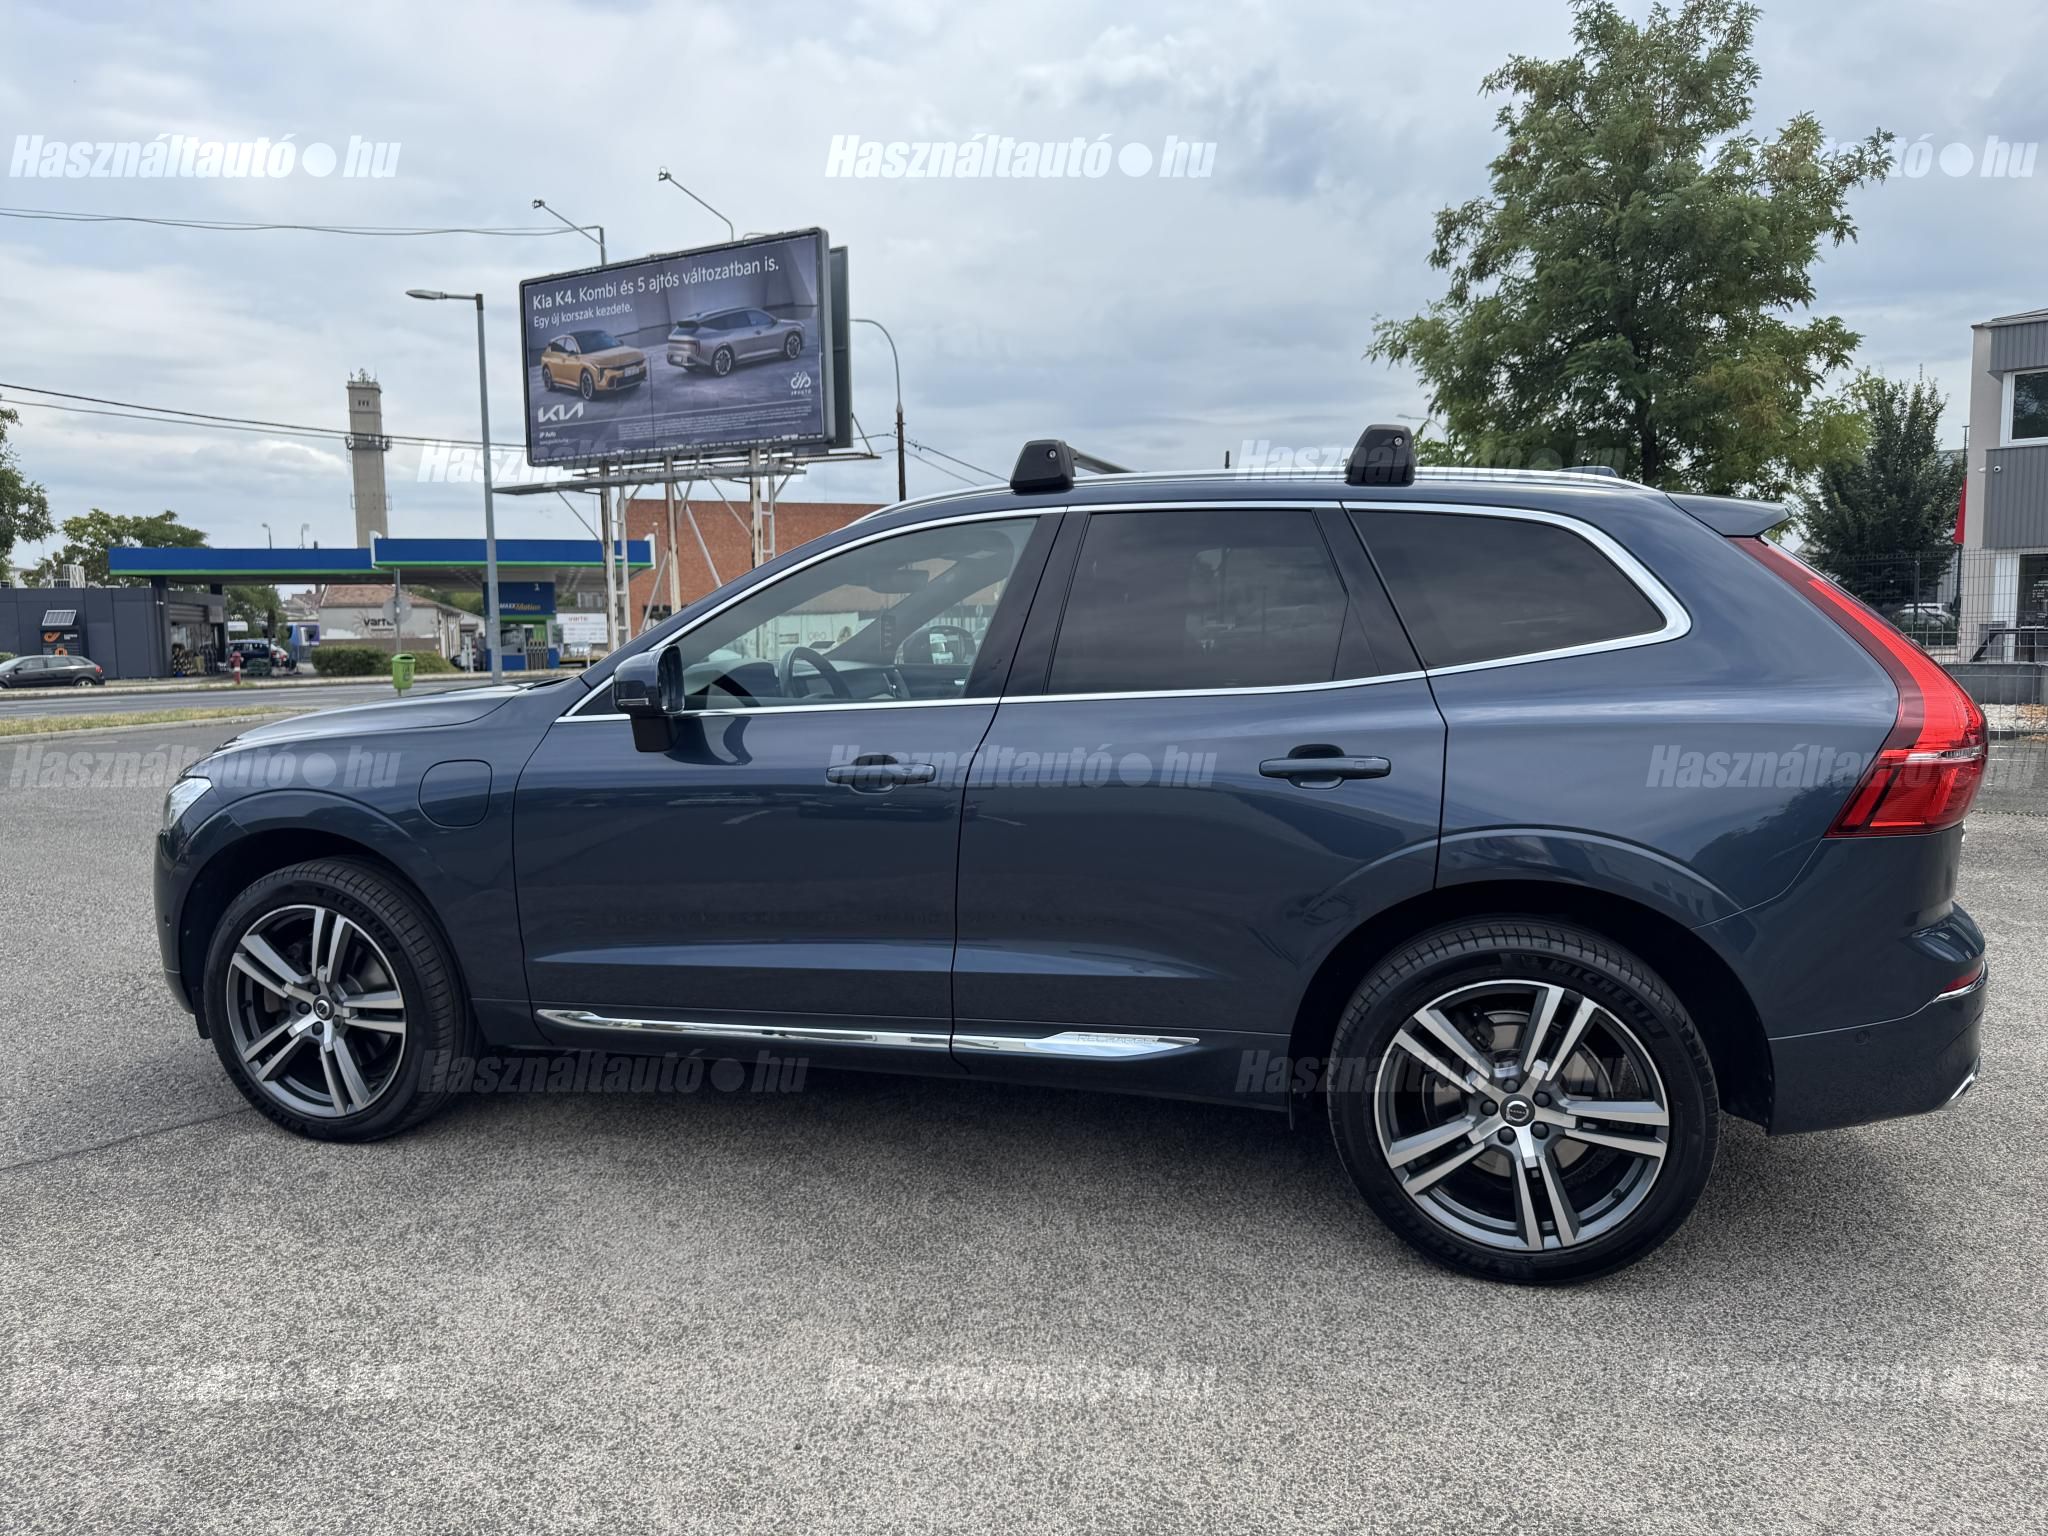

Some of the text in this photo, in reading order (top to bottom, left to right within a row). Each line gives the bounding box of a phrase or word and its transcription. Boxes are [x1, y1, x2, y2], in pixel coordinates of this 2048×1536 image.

[532, 255, 779, 311] Kia K4. Kombi és 5 ajtós változatban is.
[533, 302, 633, 330] Egy új korszak kezdete.
[537, 401, 584, 423] KIA
